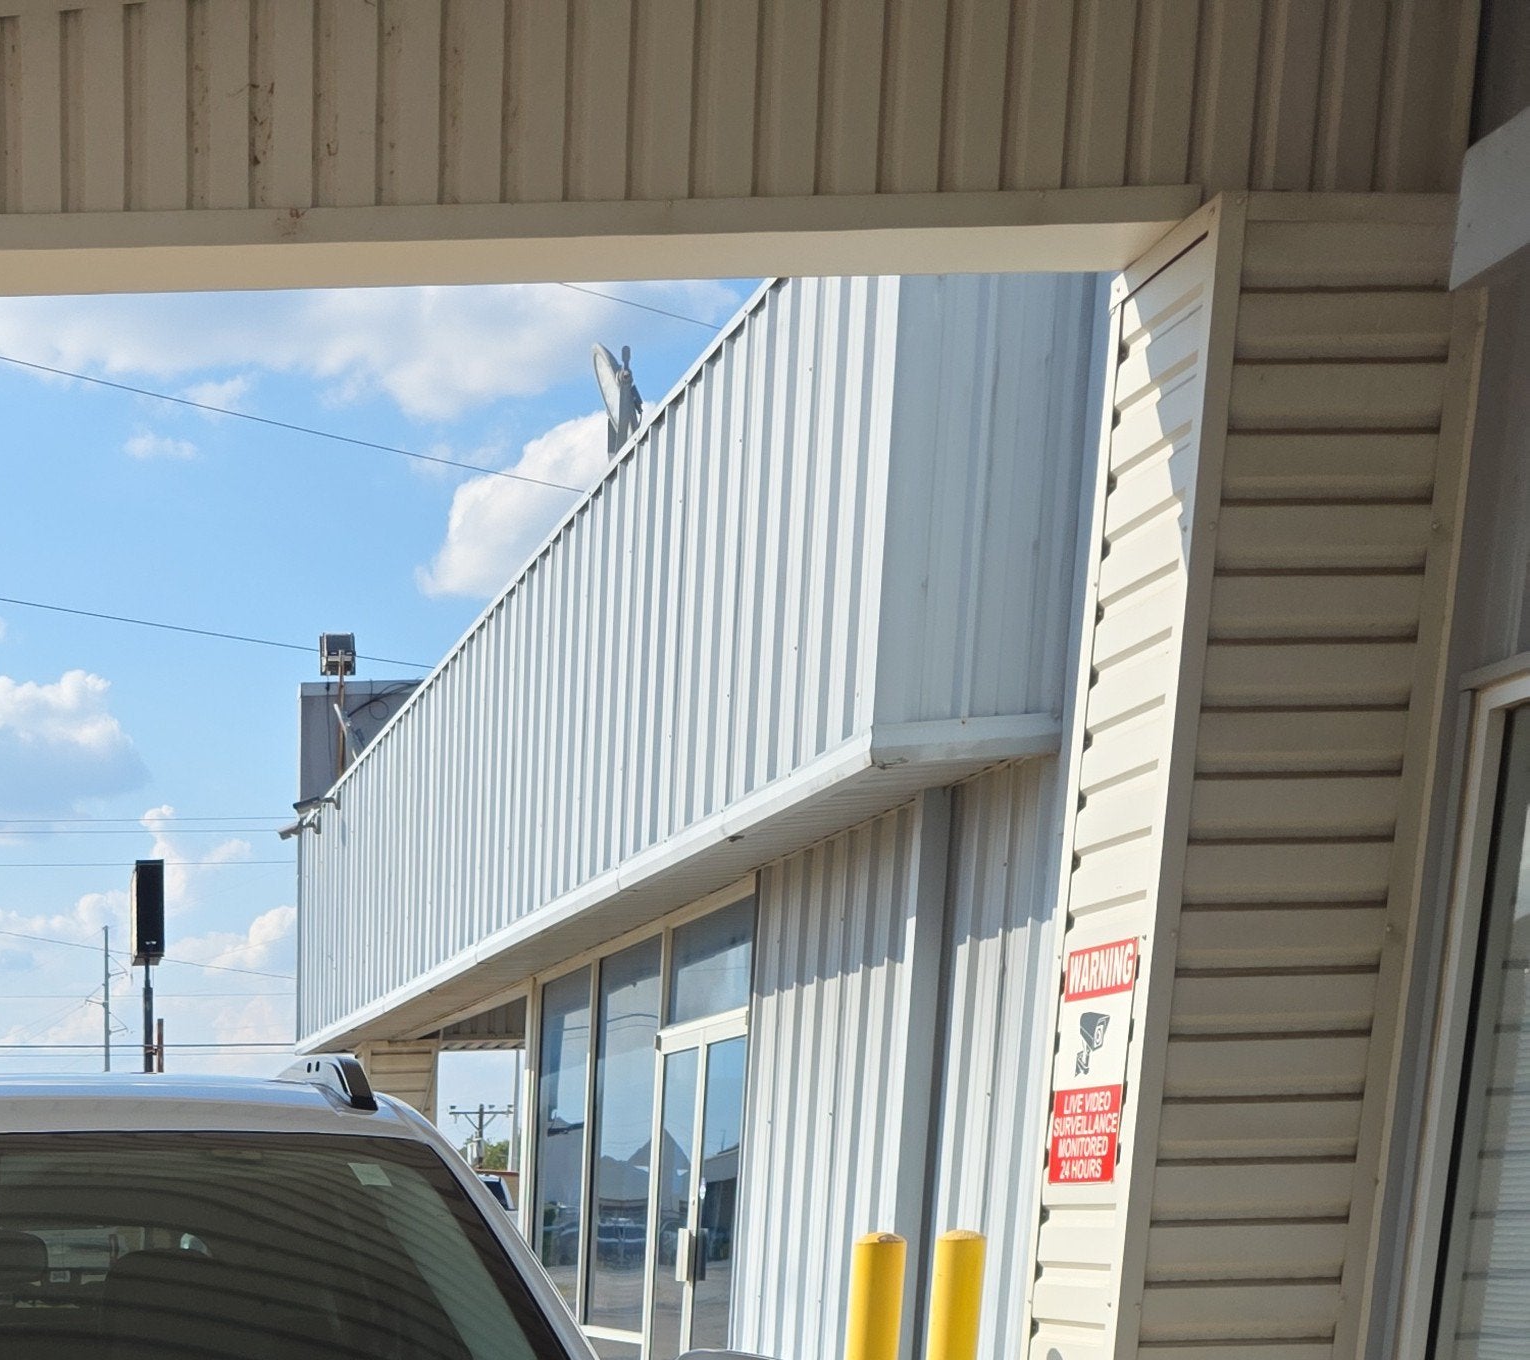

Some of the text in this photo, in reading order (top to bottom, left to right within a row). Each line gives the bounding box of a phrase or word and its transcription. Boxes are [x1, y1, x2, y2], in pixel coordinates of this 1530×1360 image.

[1069, 943, 1134, 995] WARNING
[1063, 1090, 1112, 1115] LIVE VIDEO
[1053, 1112, 1119, 1137] SURVEILLANCE
[1058, 1135, 1109, 1158] MONITORED
[1059, 1158, 1102, 1179] 24 HOURS
